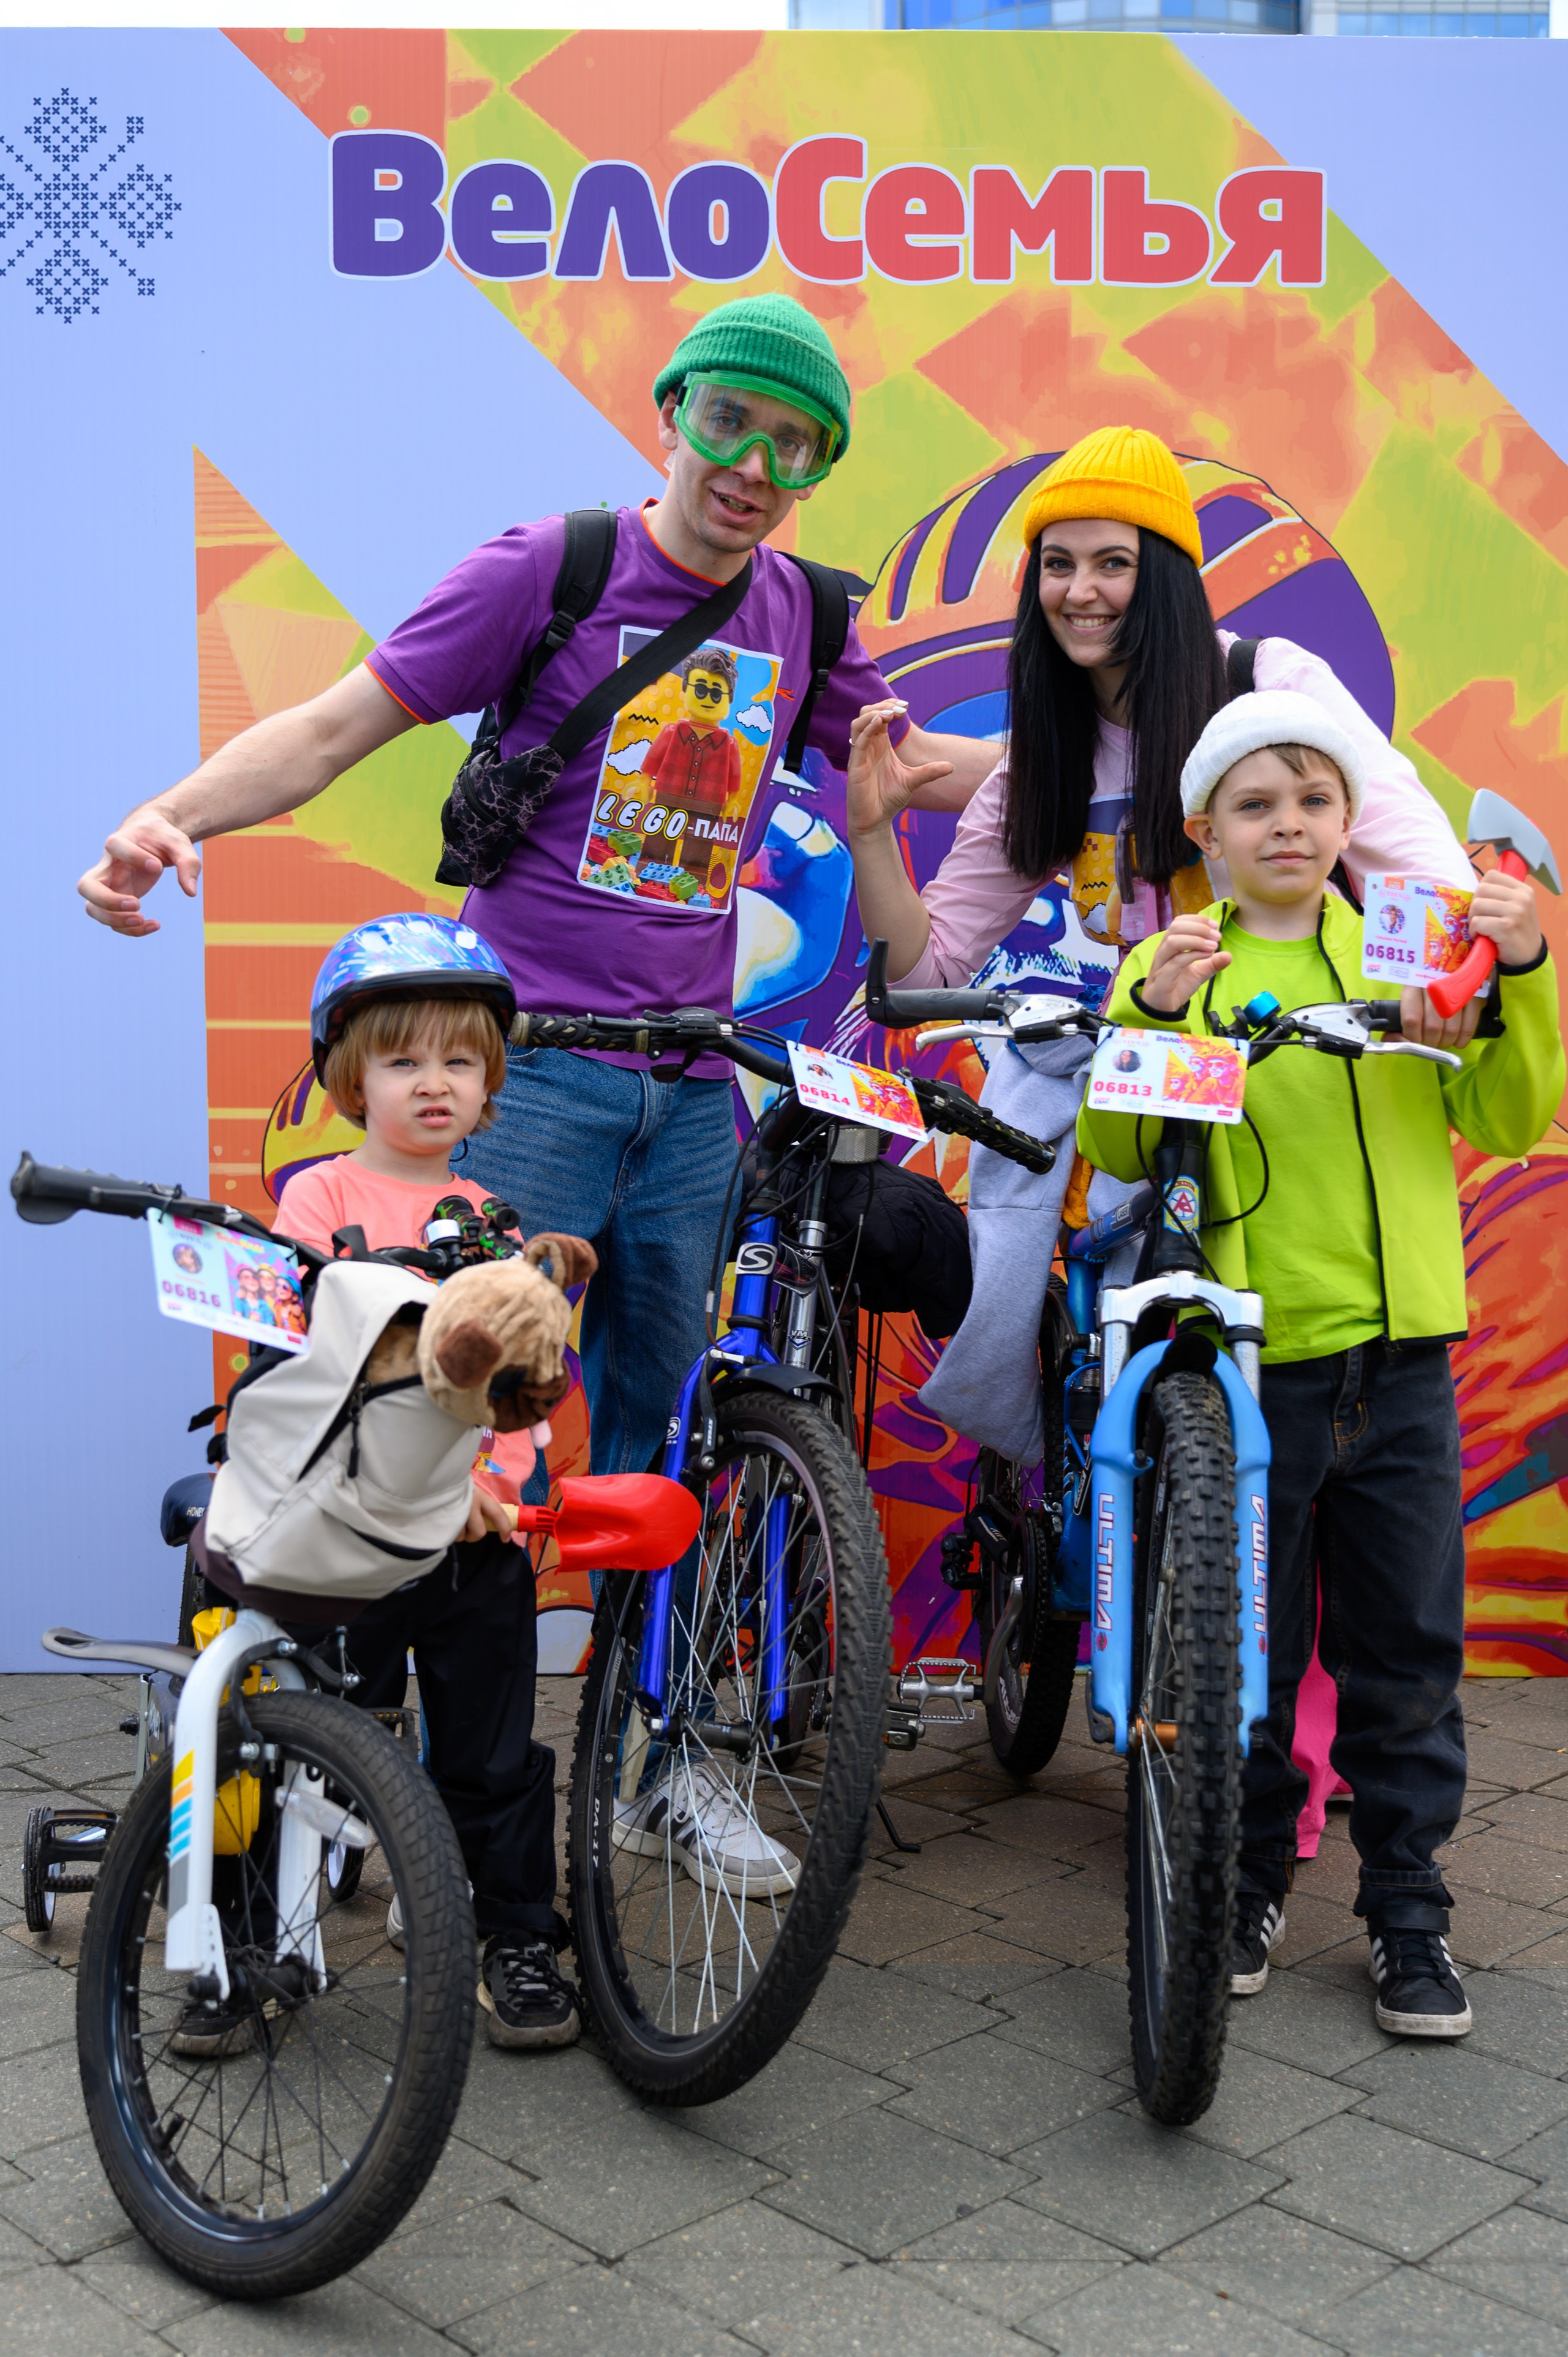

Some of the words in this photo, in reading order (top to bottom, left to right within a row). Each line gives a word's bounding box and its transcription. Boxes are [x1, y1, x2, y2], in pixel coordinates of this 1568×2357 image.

[331, 132, 1325, 285] ВелоСемья
[596, 793, 739, 843] LEGO-ПАПА
[1365, 943, 1415, 964] 06815
[799, 1084, 851, 1106] 06814
[1093, 1080, 1153, 1096] 06813
[162, 1280, 222, 1308] 06816
[186, 1506, 205, 1517] HONEY
[1096, 1493, 1114, 1631] ULTIMA
[1251, 1494, 1267, 1634] ULTIMA
